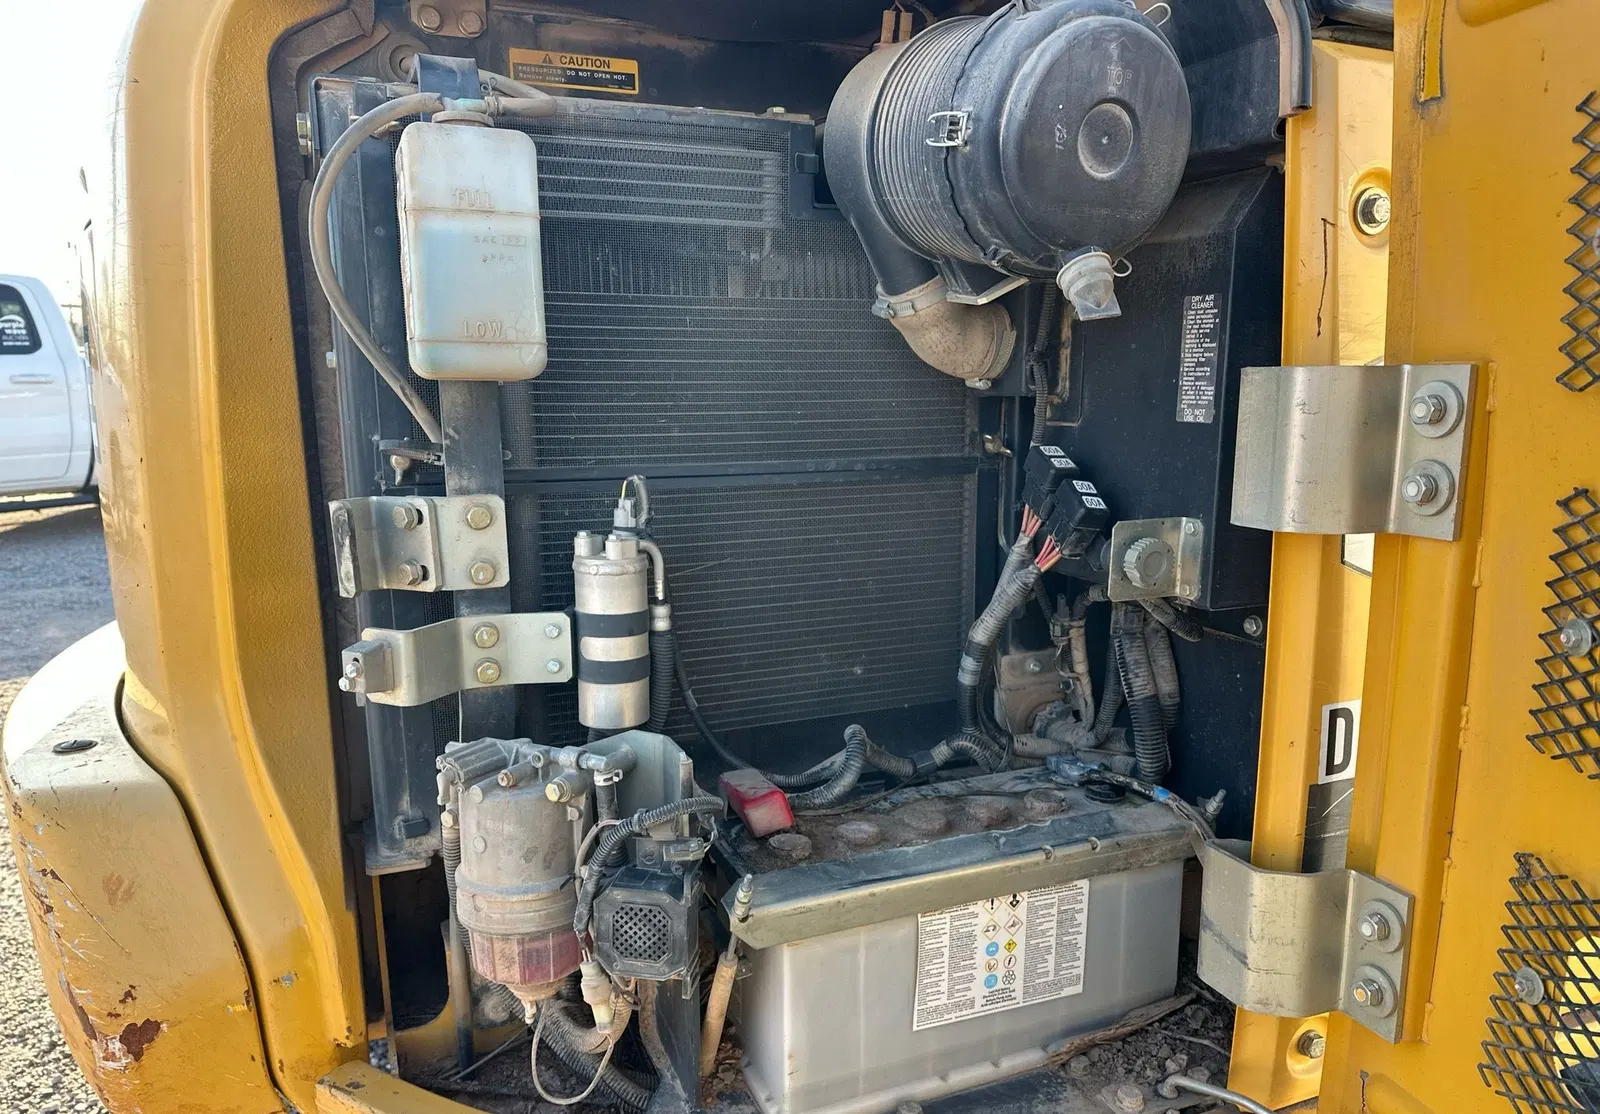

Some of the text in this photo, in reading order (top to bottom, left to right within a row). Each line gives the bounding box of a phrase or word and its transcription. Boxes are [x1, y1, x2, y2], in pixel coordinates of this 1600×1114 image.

[559, 55, 611, 69] CAUTION
[463, 318, 502, 338] LOW
[1183, 408, 1206, 416] DO NOT
[1076, 482, 1095, 492] 50A
[1085, 498, 1104, 508] 60A
[1325, 707, 1354, 776] D
